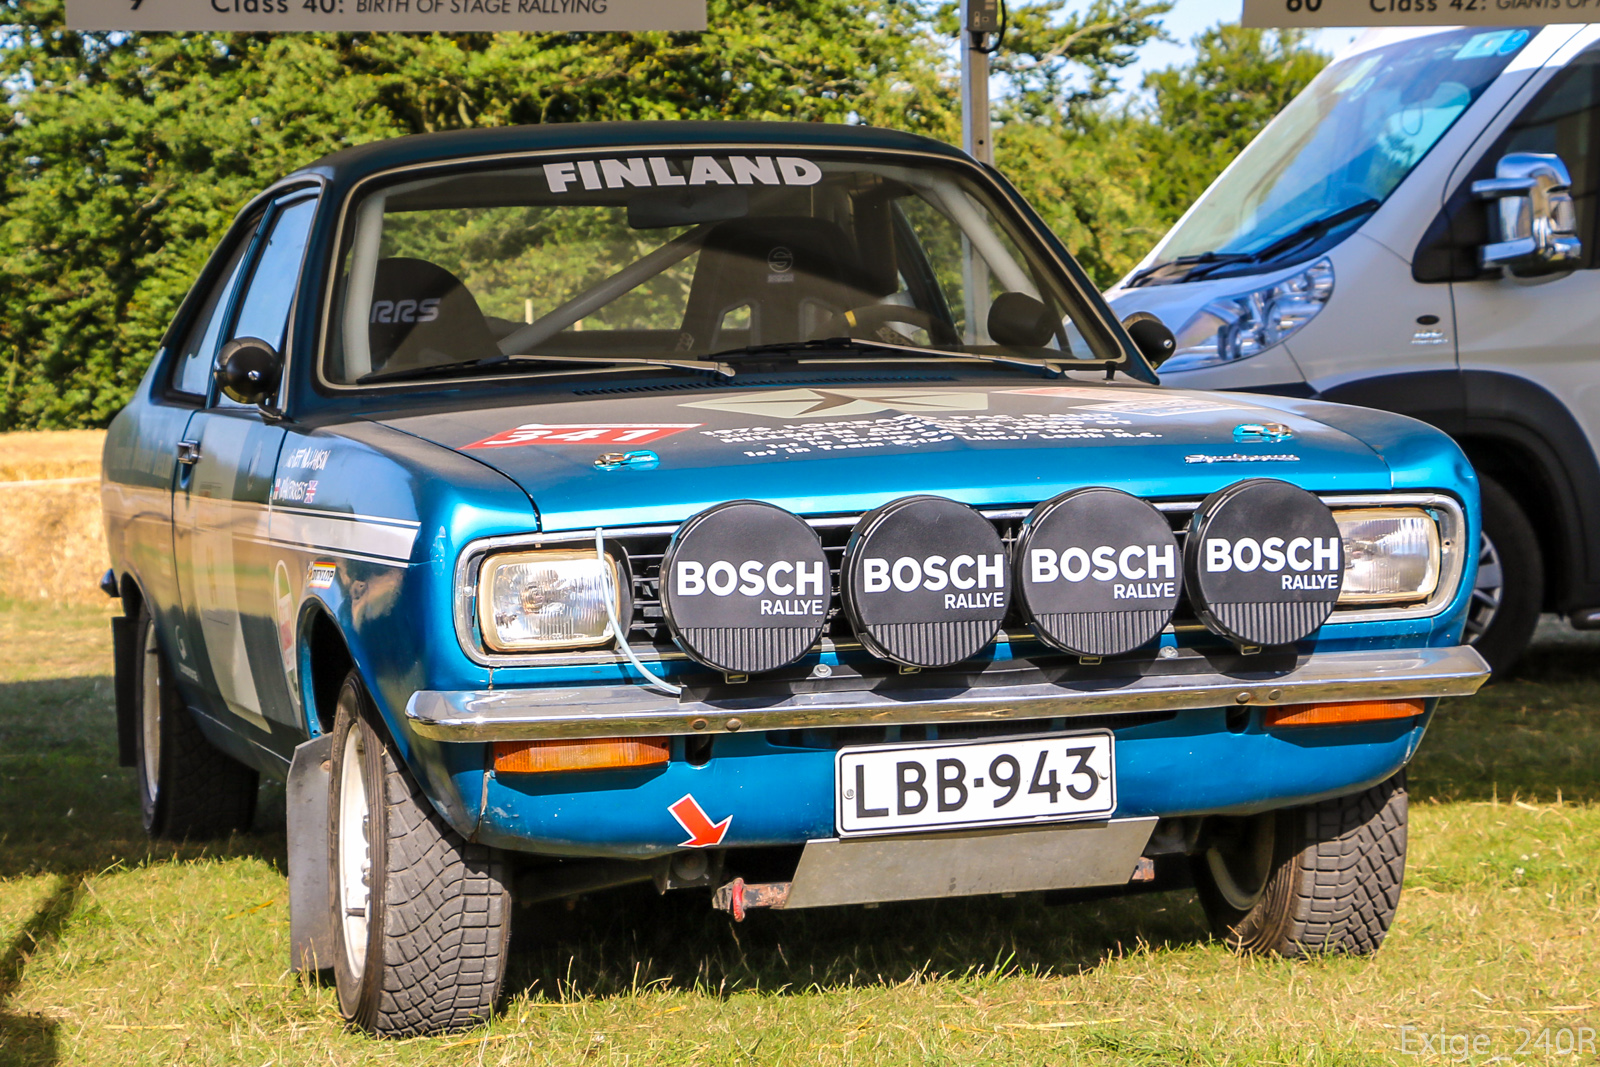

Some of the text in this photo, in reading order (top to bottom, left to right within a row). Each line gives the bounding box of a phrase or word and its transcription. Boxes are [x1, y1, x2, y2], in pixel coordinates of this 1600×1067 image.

[210, 0, 607, 13] Class 40: BIRTH OF STAGE RALLYING
[1369, 0, 1438, 12] Class
[1496, 0, 1561, 11] GIANTS
[543, 155, 822, 193] FINLAND
[370, 298, 442, 323] RRS
[482, 429, 660, 445] 341
[817, 441, 885, 451] Team
[892, 435, 955, 446] Prize
[1030, 545, 1176, 583] BOSCH
[1206, 537, 1339, 573] BOSCH
[677, 560, 824, 597] BOSCH
[863, 553, 1005, 593] BOSCH
[1281, 573, 1339, 590] RALLYE
[1113, 582, 1176, 599] RALLYE
[760, 599, 824, 615] RALLYE
[944, 592, 1005, 610] RALLYE
[855, 745, 1099, 819] LBB-943
